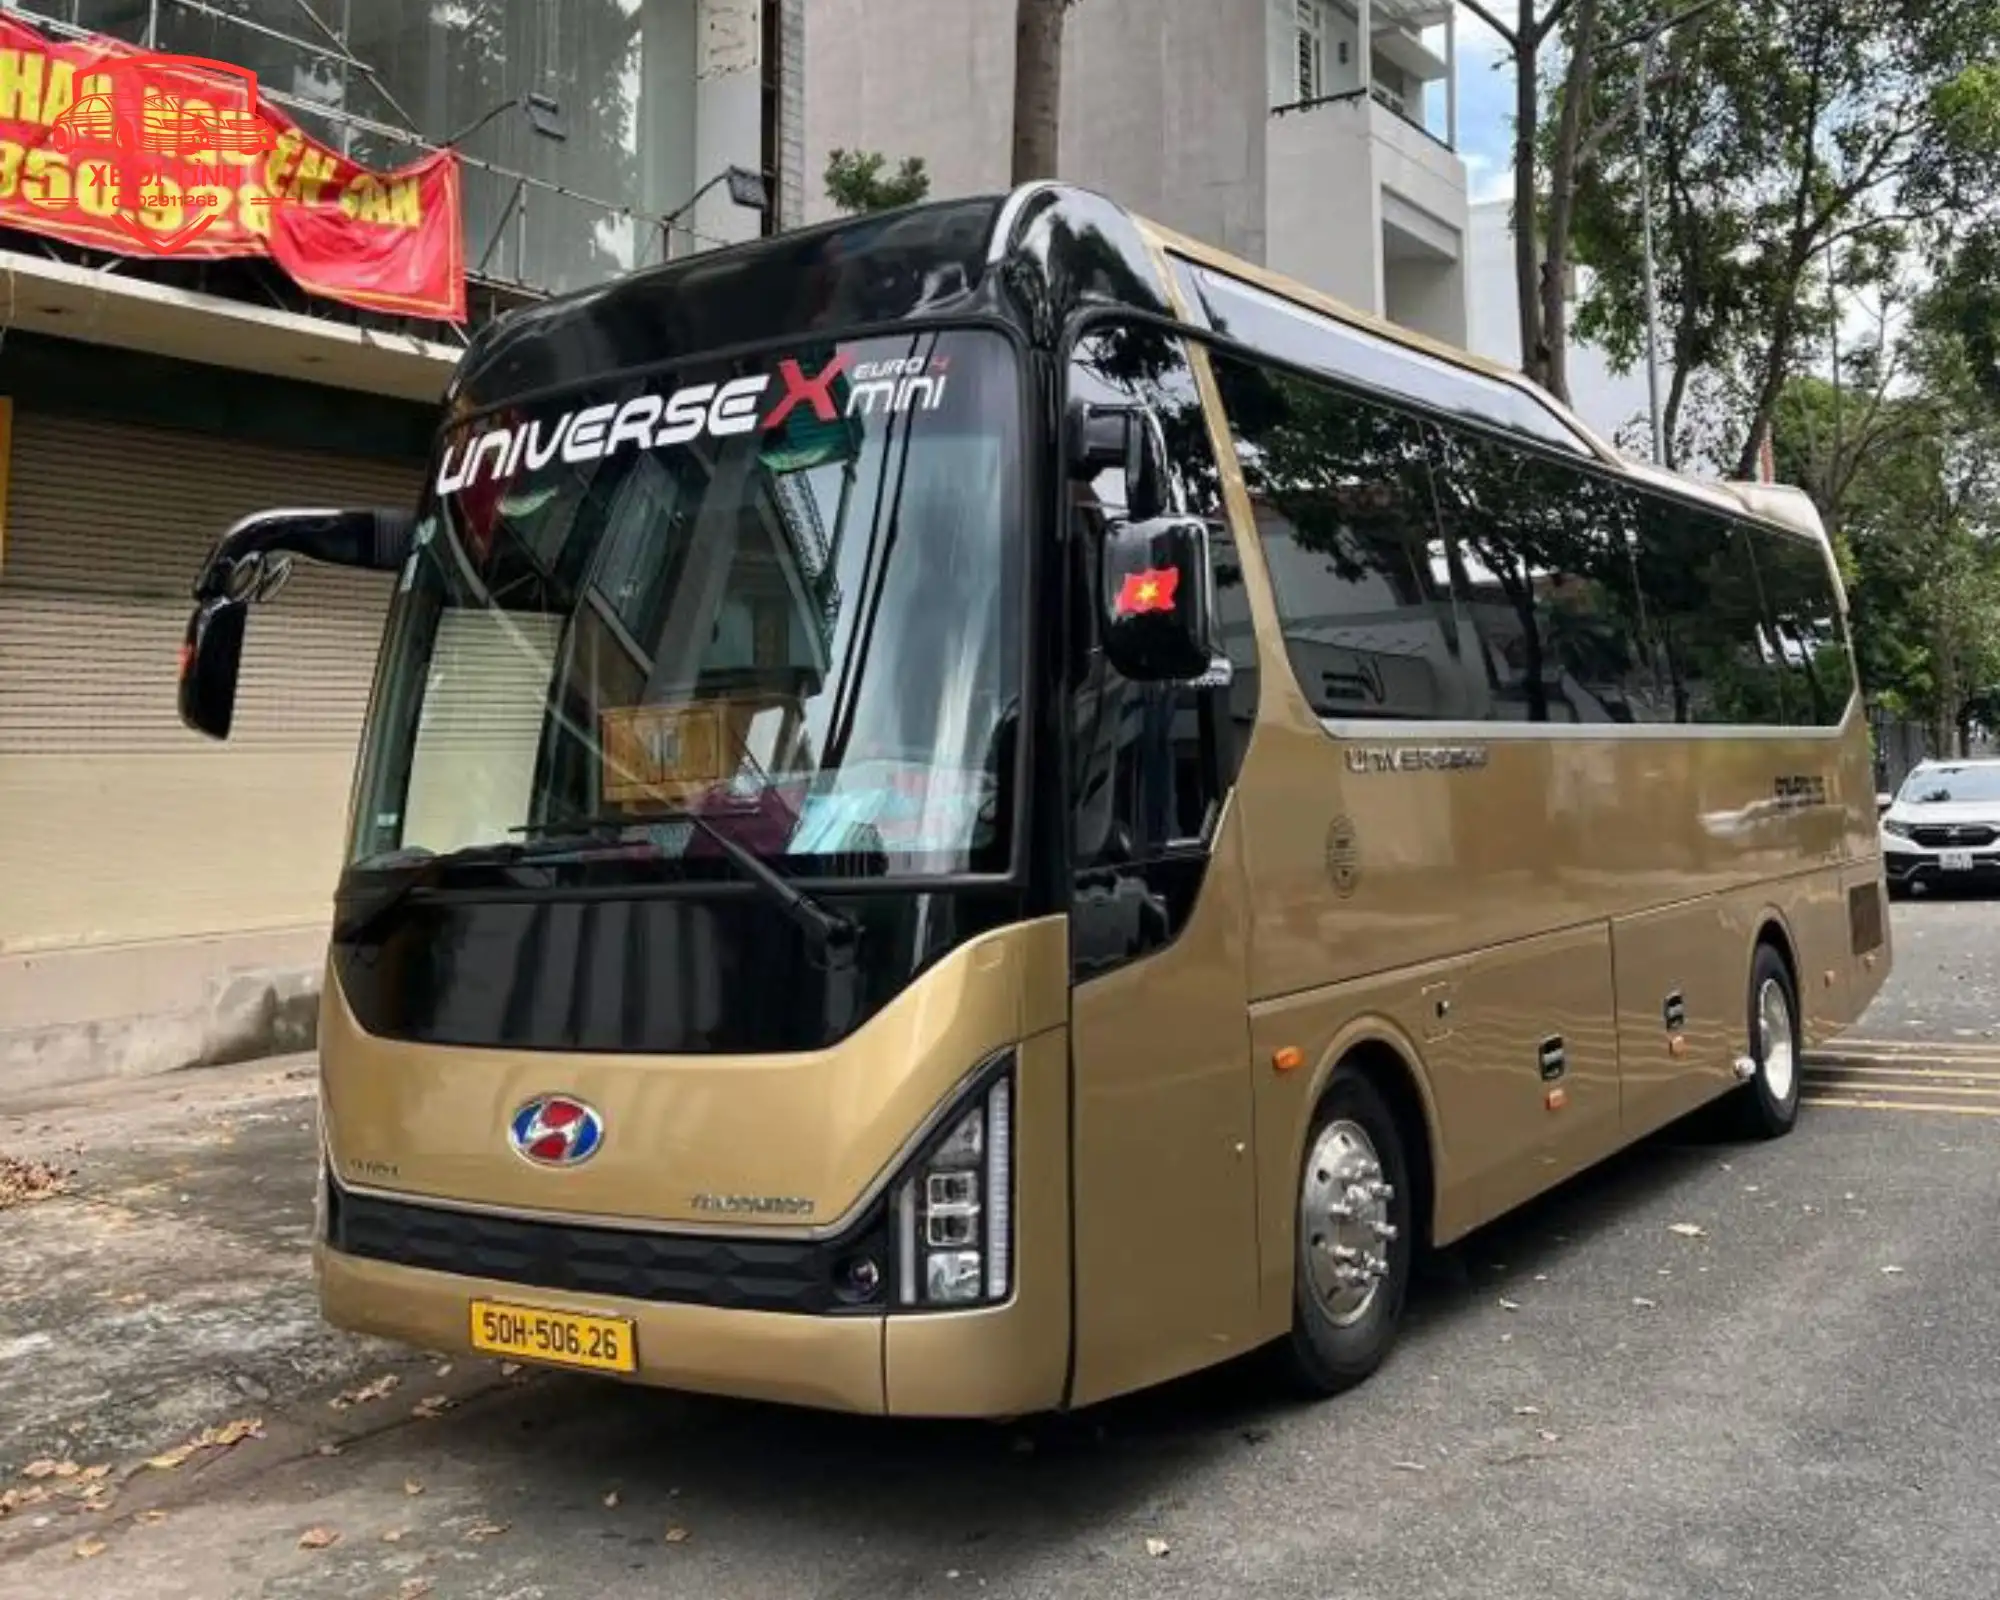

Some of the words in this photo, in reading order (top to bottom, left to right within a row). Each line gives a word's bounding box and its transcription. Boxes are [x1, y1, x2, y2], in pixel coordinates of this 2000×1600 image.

[853, 356, 925, 380] EURO
[436, 374, 771, 496] UNIVERSE
[762, 349, 856, 430] X
[483, 1311, 618, 1361] 50H-506.26
